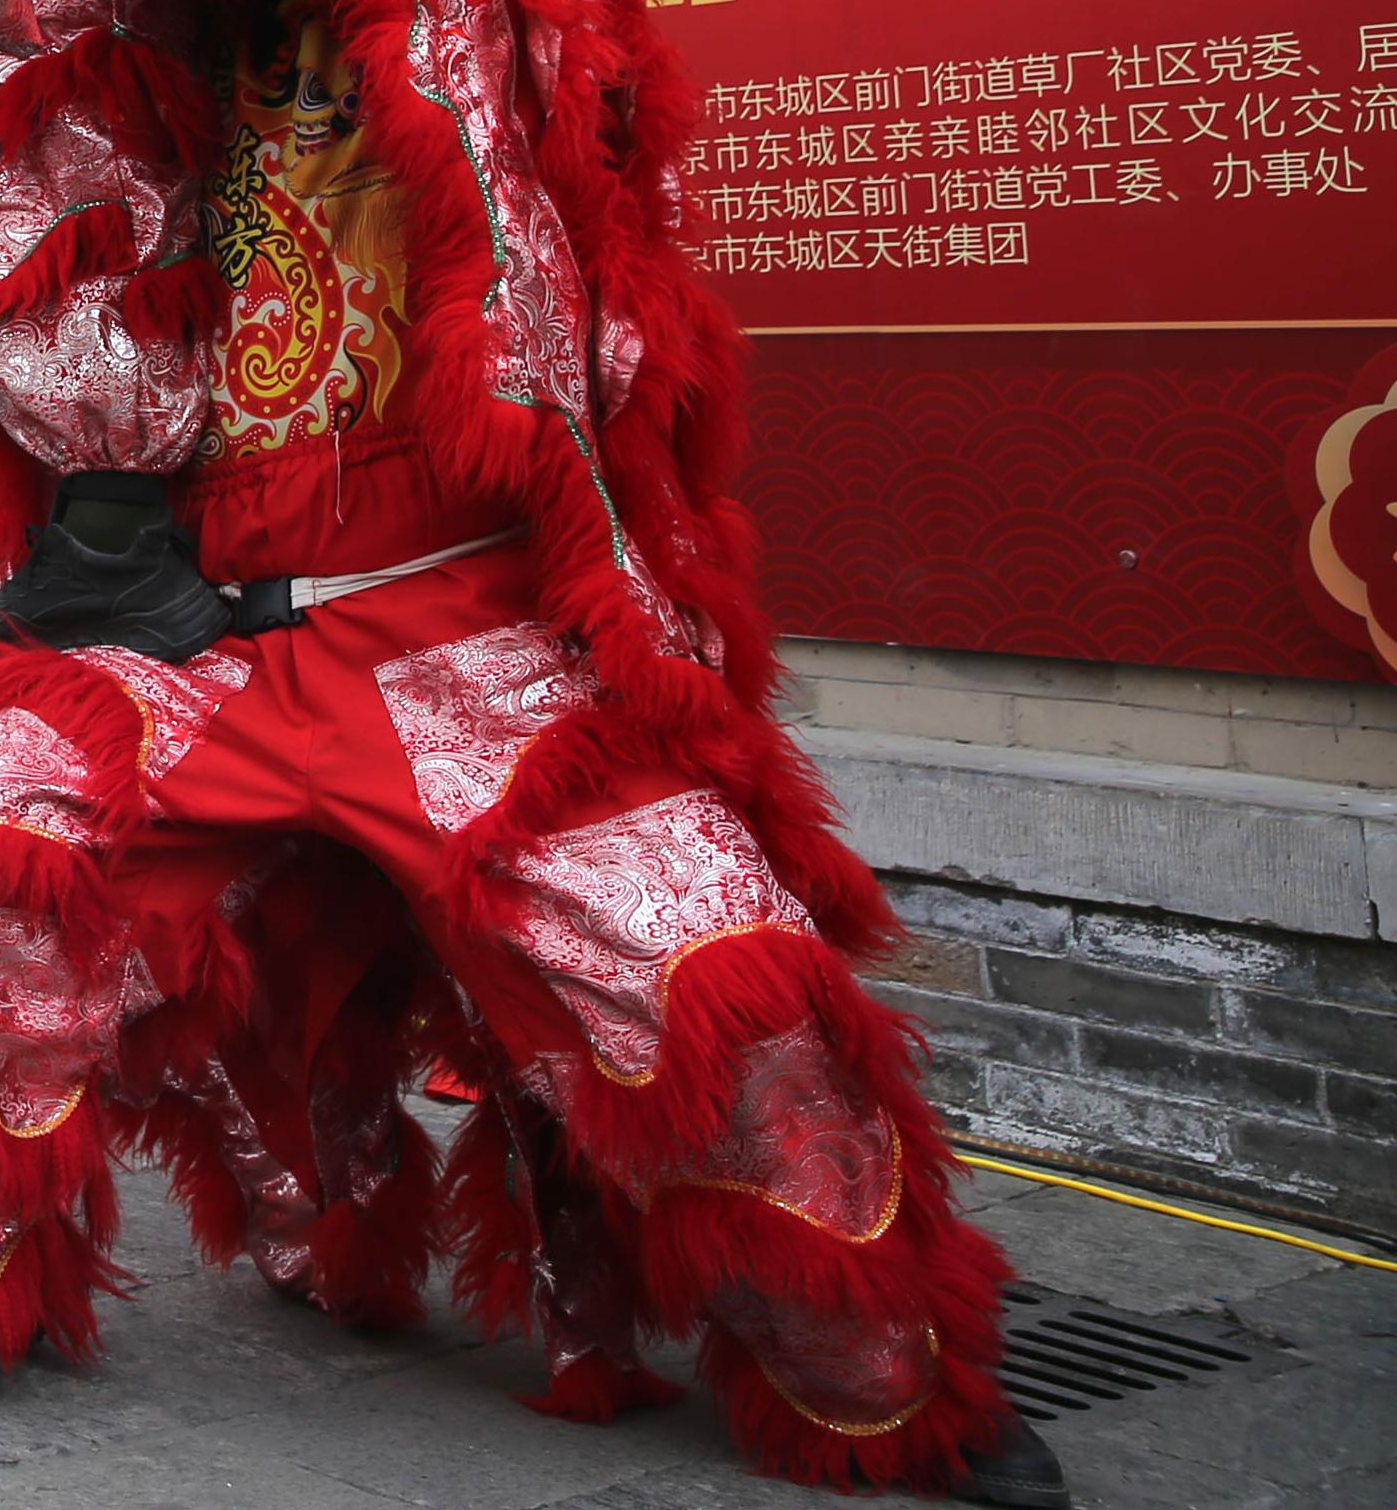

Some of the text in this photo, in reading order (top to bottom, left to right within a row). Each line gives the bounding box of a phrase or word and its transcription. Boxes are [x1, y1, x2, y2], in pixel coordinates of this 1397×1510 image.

[688, 145, 1368, 224] 市东城区前门街道党工委、办事处
